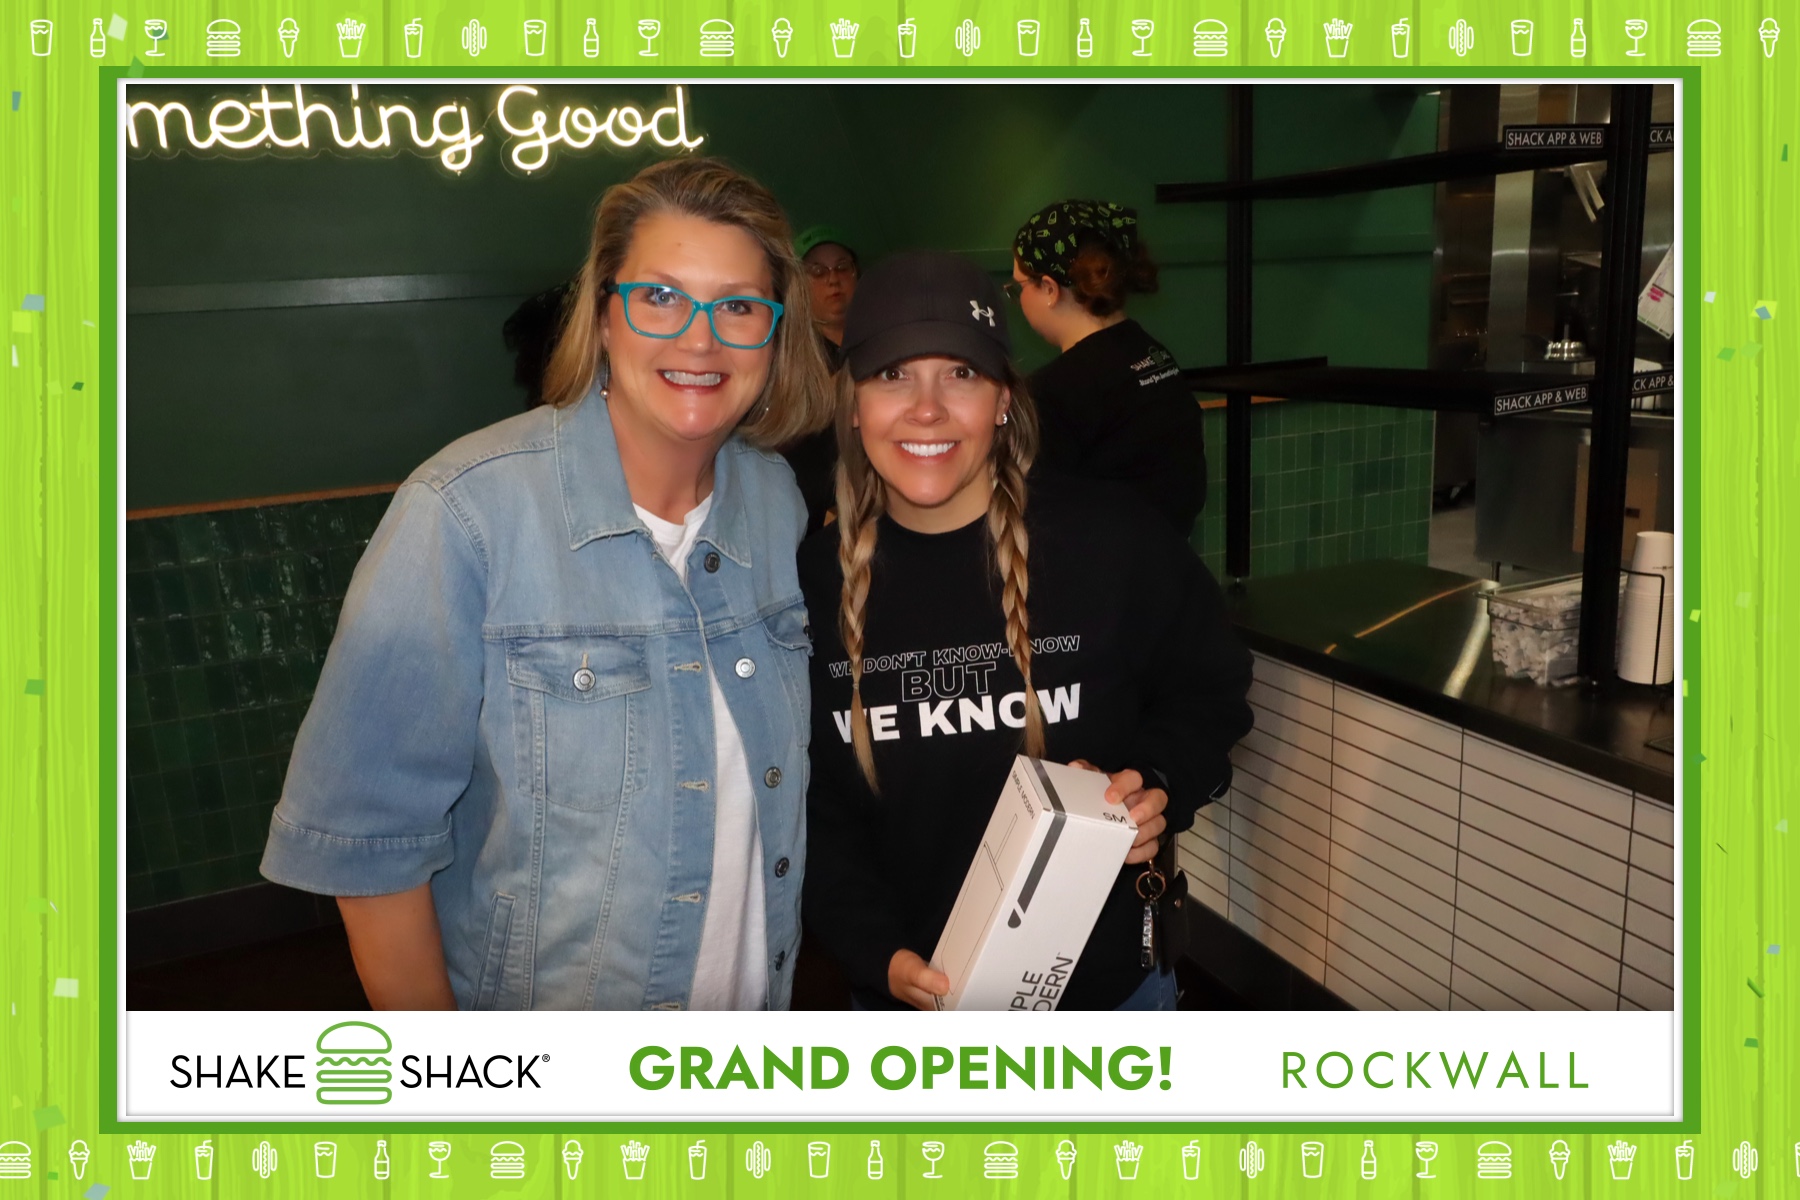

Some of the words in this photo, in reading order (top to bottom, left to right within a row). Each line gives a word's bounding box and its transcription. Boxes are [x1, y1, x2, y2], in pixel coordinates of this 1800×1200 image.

[498, 85, 704, 170] Good
[1507, 131, 1545, 147] SHACK
[1546, 131, 1567, 146] APP
[1568, 131, 1577, 146] &
[1579, 131, 1602, 145] WEB
[1632, 377, 1647, 391] CK
[1648, 375, 1666, 389] APP
[1496, 395, 1532, 413] SHACK
[1533, 392, 1554, 407] APP
[1555, 391, 1563, 404] &
[1564, 386, 1588, 401] WEB
[863, 650, 927, 674] DON'T
[901, 660, 997, 703] BUT
[832, 704, 901, 744] WE
[917, 682, 1082, 738] KNOW
[1102, 811, 1128, 824] SM
[1008, 970, 1044, 1012] PLE
